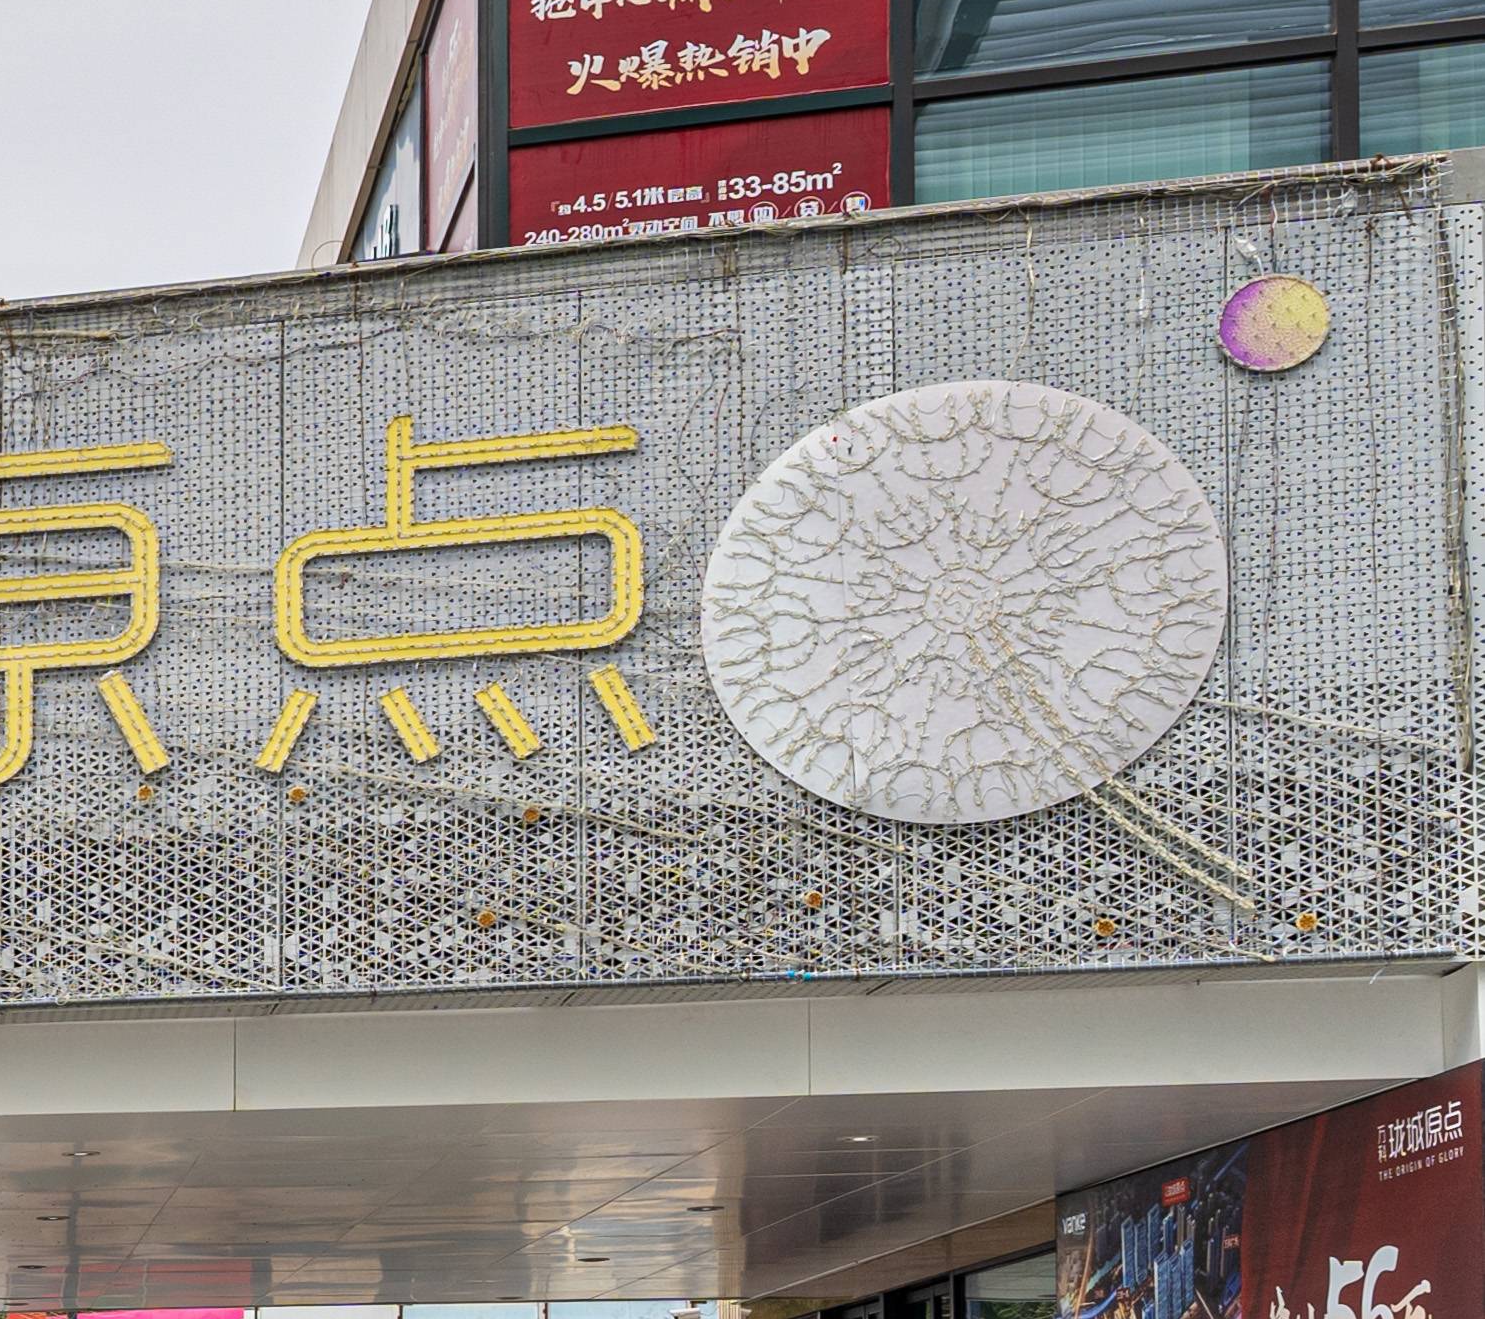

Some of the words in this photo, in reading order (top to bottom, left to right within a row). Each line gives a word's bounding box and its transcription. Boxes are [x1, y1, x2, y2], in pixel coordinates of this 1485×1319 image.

[566, 27, 832, 96] 火爆热销中
[1388, 1100, 1463, 1159] 珑城原点
[1379, 1169, 1393, 1181] THE
[1395, 1161, 1423, 1177] ORIGIN
[1426, 1156, 1436, 1168] OF
[1438, 1146, 1465, 1165] GLORY
